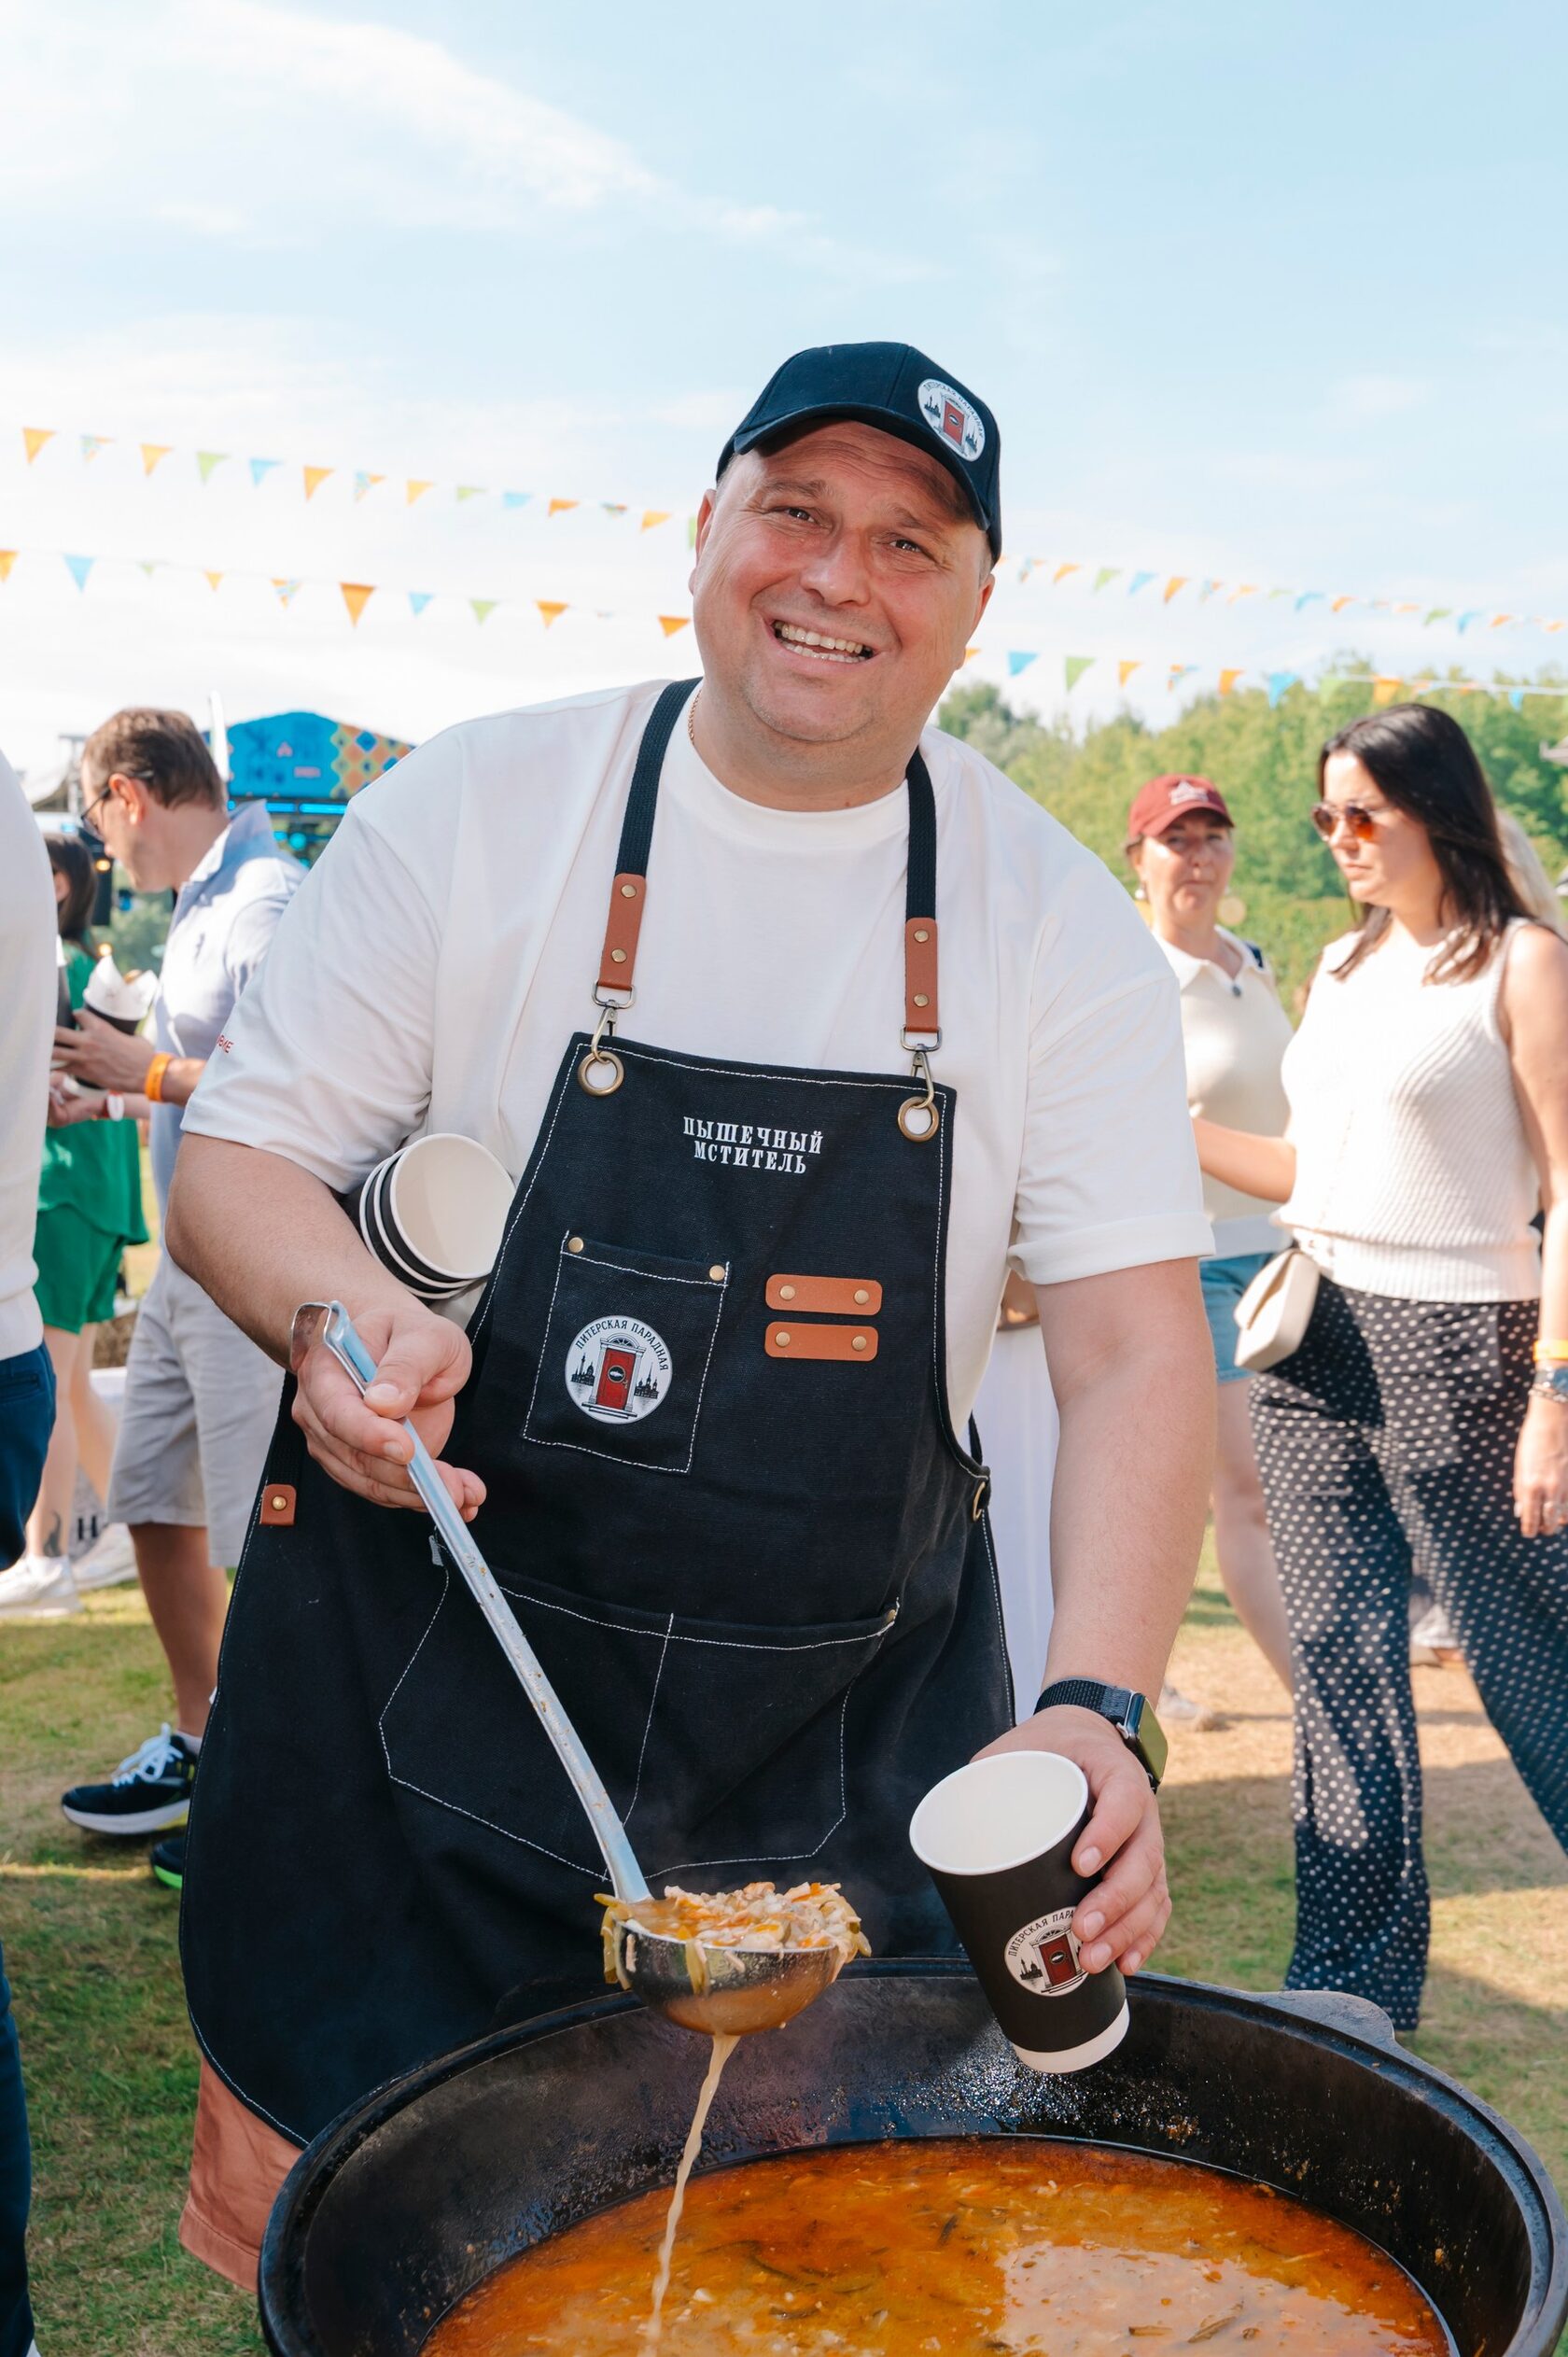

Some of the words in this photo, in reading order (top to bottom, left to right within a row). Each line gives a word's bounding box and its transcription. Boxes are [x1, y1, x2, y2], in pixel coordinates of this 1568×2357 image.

[683, 1115, 823, 1154] ПЫШЕЧНЫЙ
[694, 1140, 806, 1174] МСТИТЕЛЬ
[575, 1319, 628, 1350] ПИТЕРСКАЯ
[631, 1323, 669, 1371] ПАРАДНАЯ
[1008, 1918, 1048, 1957] ПИТЕРСКАЯ
[1052, 1909, 1075, 1923] ПАРА
